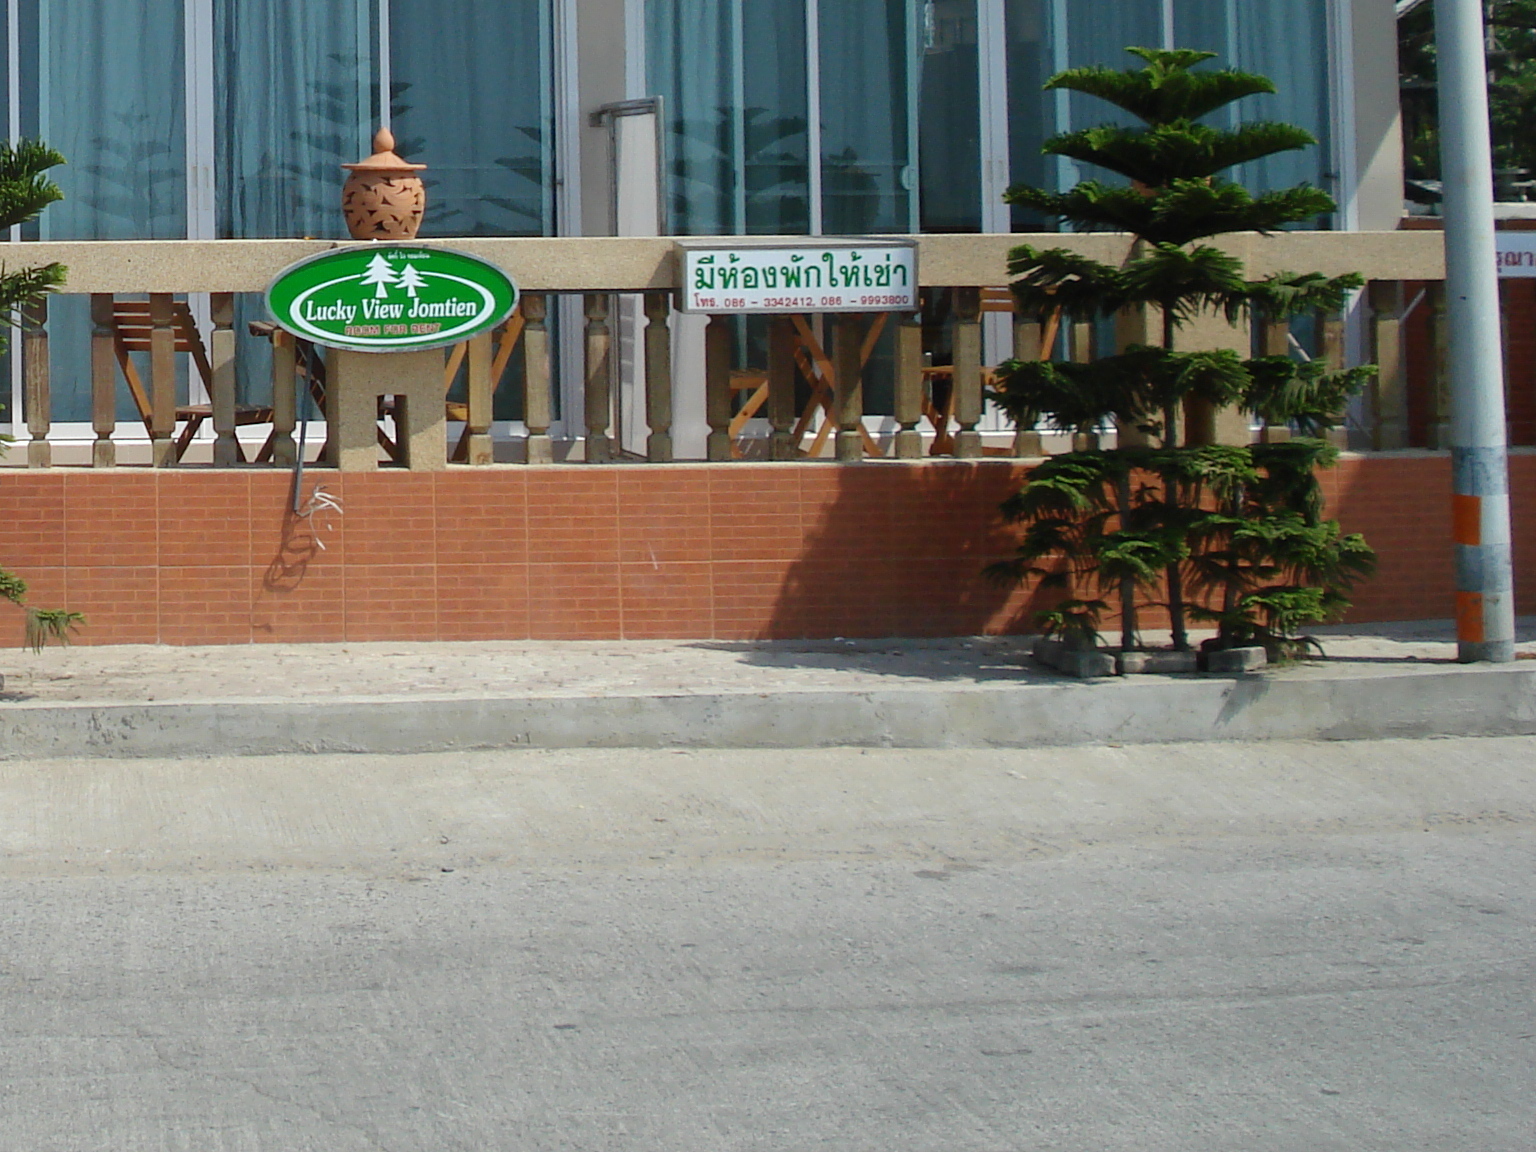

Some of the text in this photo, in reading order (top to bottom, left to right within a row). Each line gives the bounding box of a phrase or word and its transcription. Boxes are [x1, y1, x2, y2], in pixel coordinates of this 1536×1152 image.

[695, 251, 907, 289] มีห้องพักให้เช่า
[860, 294, 909, 306] 9993800
[306, 297, 476, 324] Lucky View Jomtien
[345, 322, 442, 336] ROOM FOR RENT
